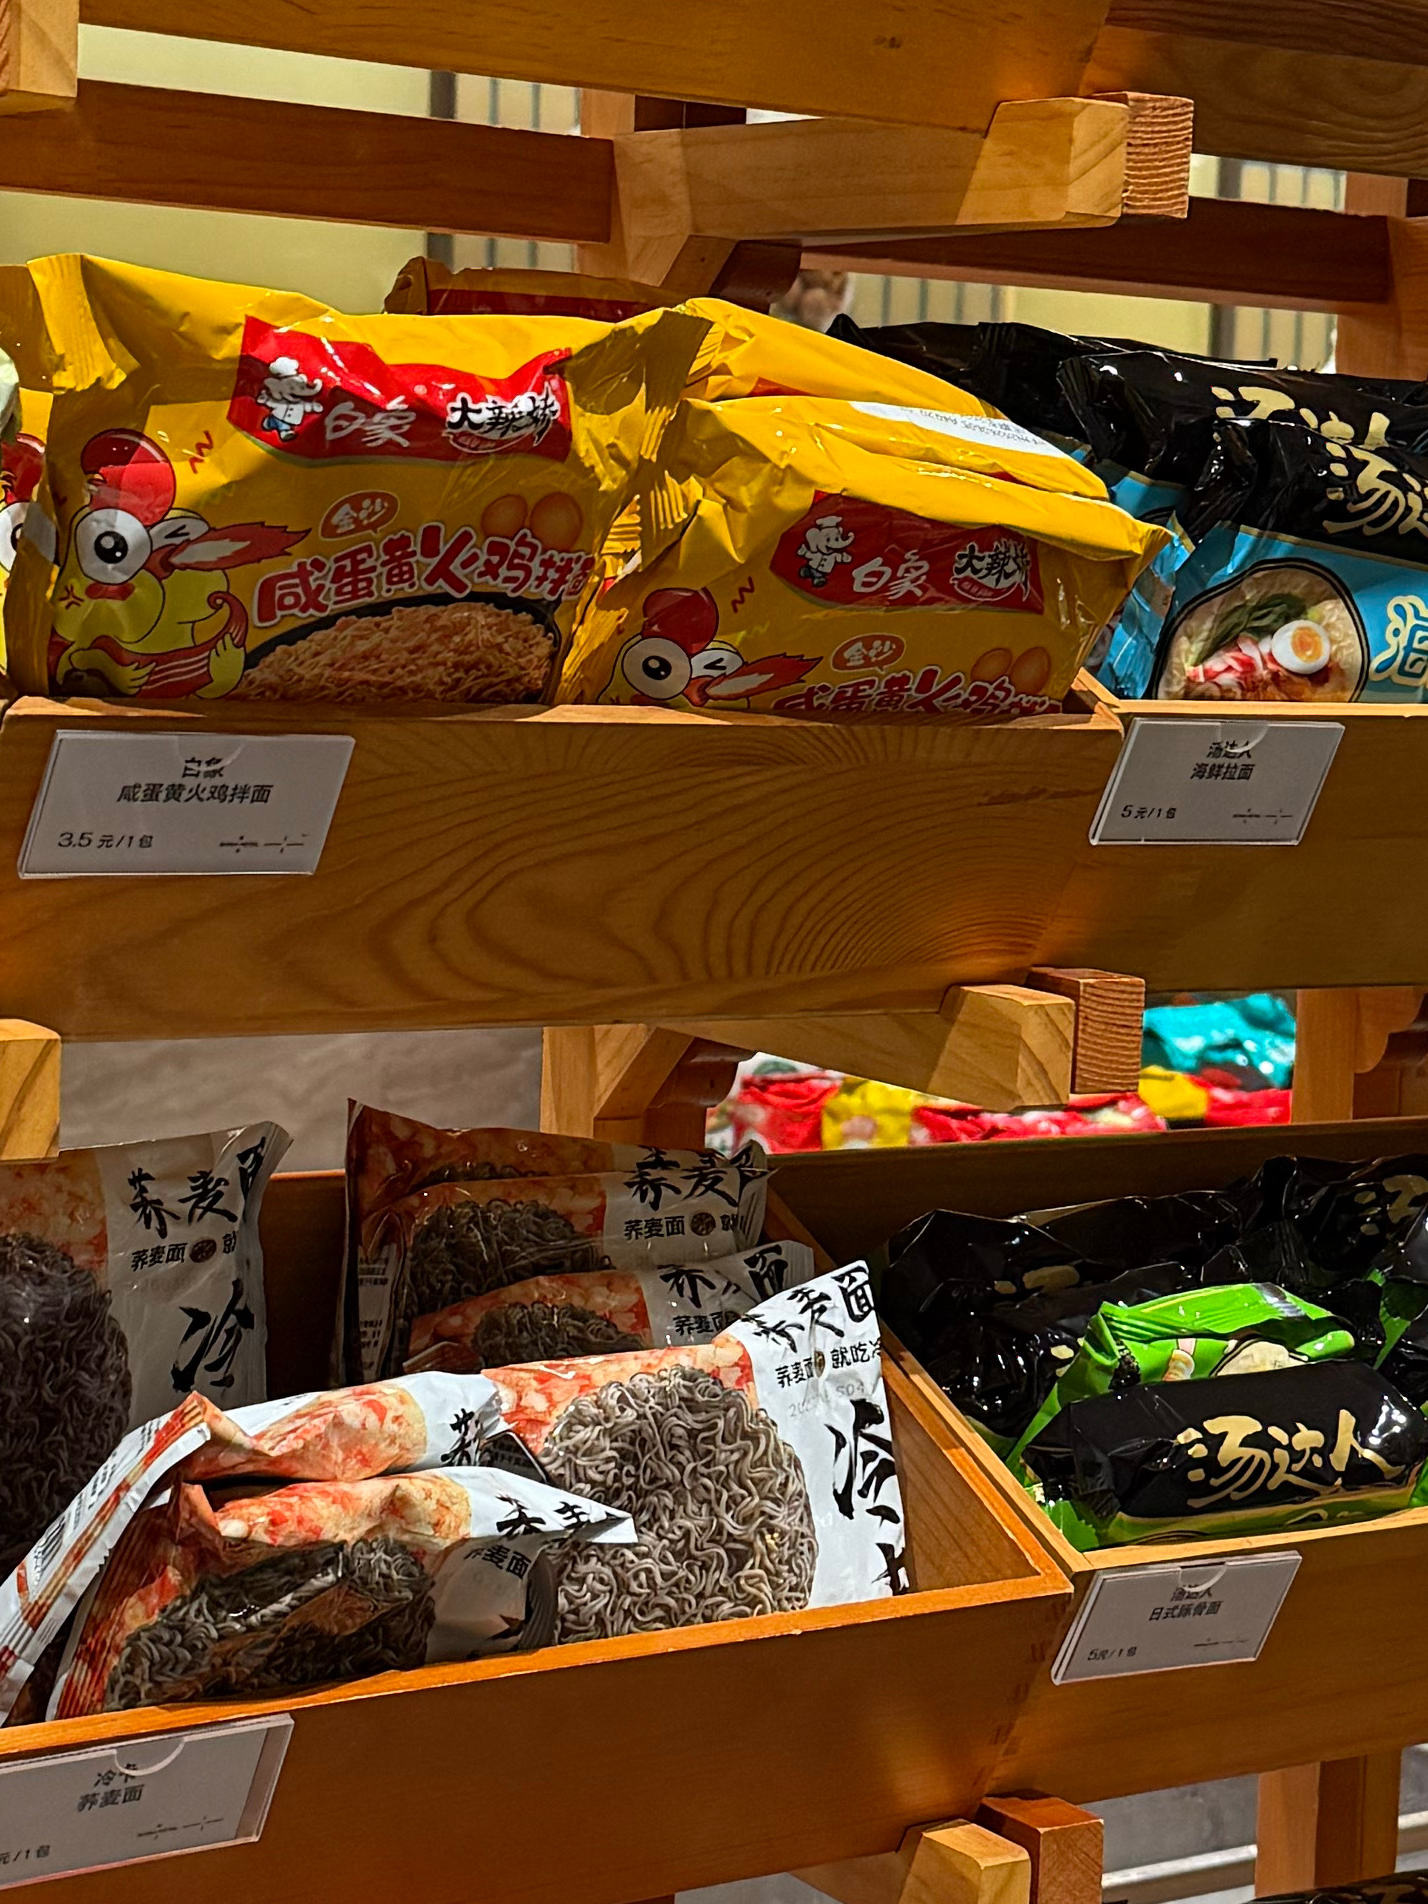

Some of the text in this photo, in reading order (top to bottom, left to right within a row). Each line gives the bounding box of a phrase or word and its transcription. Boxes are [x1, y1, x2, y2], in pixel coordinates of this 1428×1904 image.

[325, 398, 409, 448] 白象
[852, 551, 929, 599] 白象
[1206, 740, 1253, 759] 汤达人
[181, 757, 225, 778] 白象
[1190, 763, 1255, 781] 海鲜拉面
[117, 783, 274, 804] 咸蛋黄火鸡拌面
[58, 832, 93, 848] 3.5
[624, 1215, 685, 1240] 荞麦面
[131, 1242, 188, 1272] 荞麦面
[172, 1281, 254, 1391] 冷
[1177, 1409, 1406, 1509] 汤达人
[1148, 1600, 1224, 1622] 日式豚骨面
[77, 1784, 145, 1812] 荞麦面
